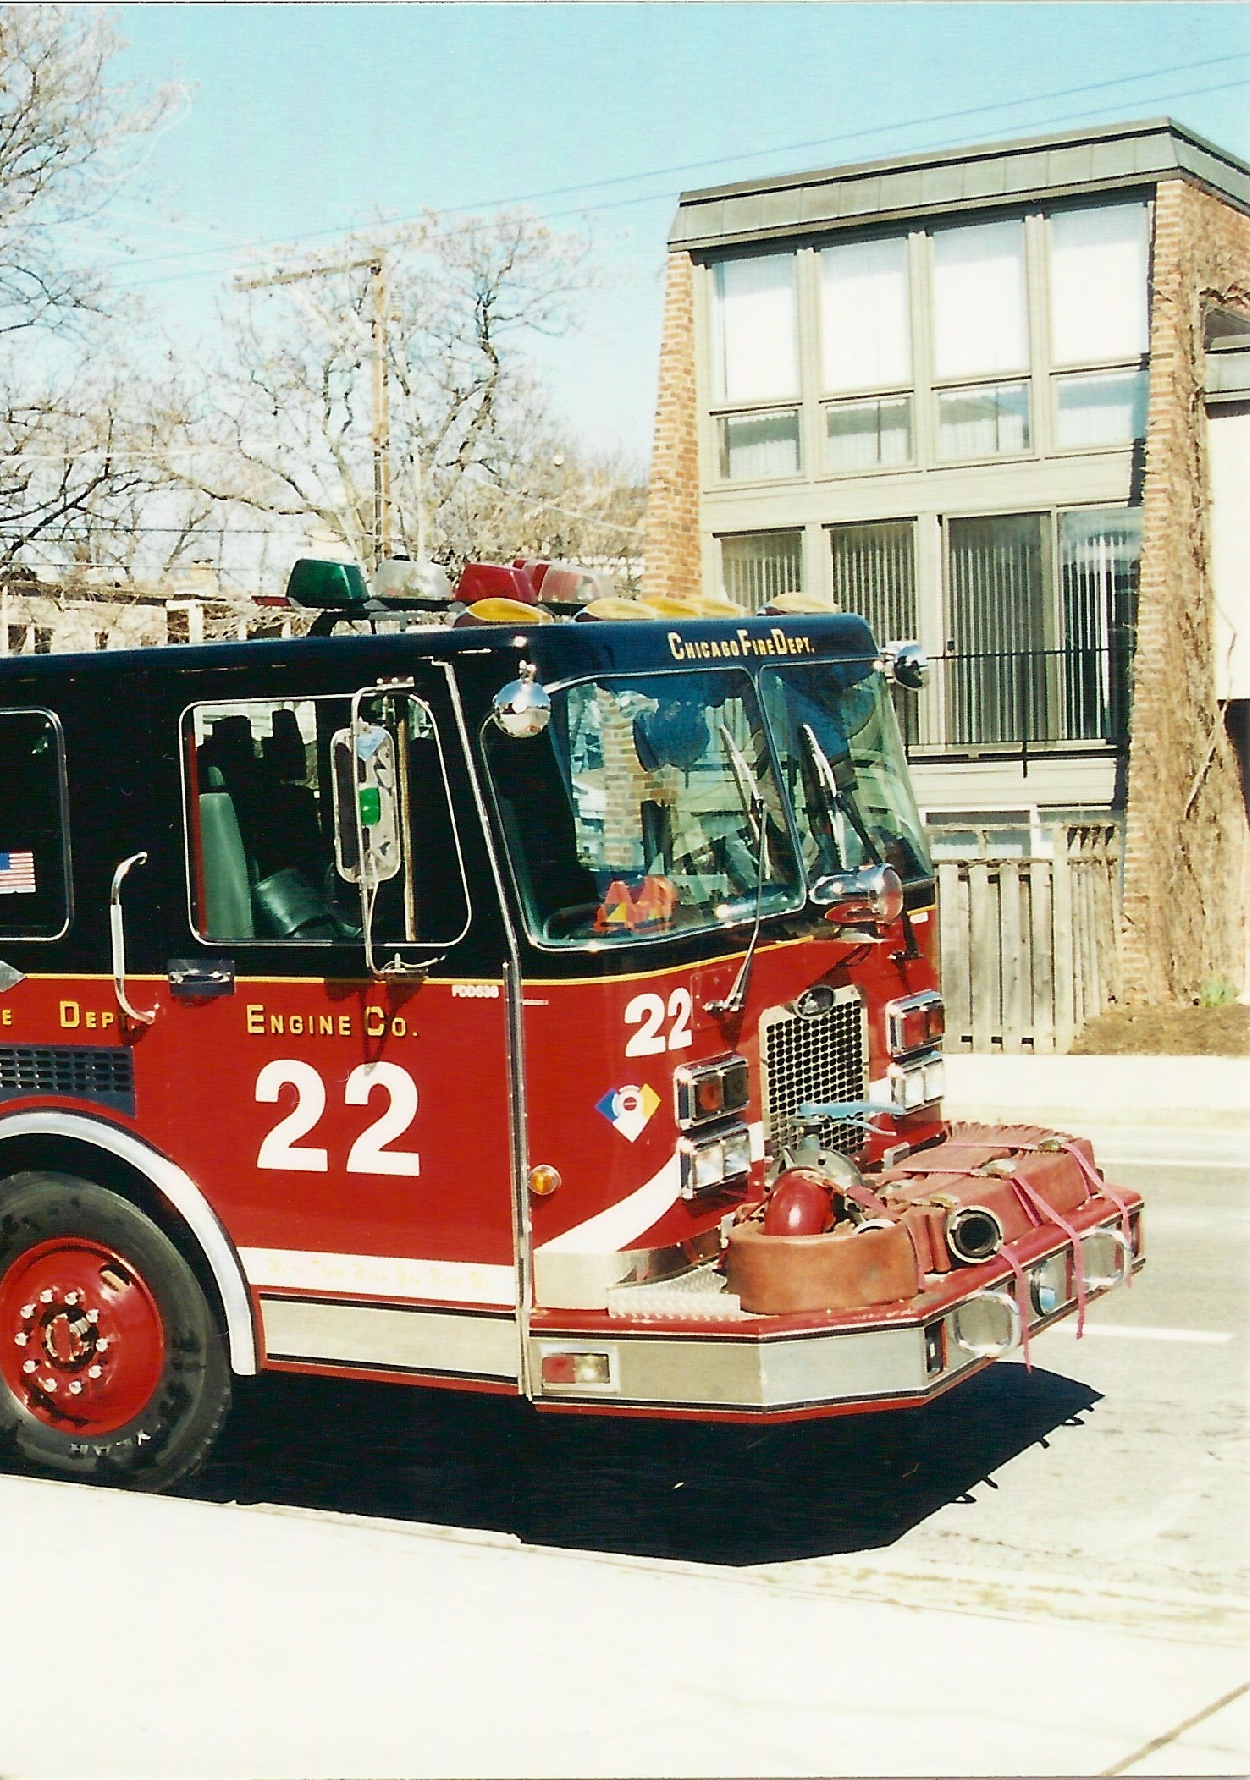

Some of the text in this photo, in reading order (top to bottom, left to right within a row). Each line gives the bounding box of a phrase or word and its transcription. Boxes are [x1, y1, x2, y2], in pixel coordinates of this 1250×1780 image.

[667, 631, 740, 660] CHICAGO
[246, 1004, 419, 1037] ENGINE CO.
[624, 987, 693, 1057] 22
[254, 1058, 421, 1178] 22
